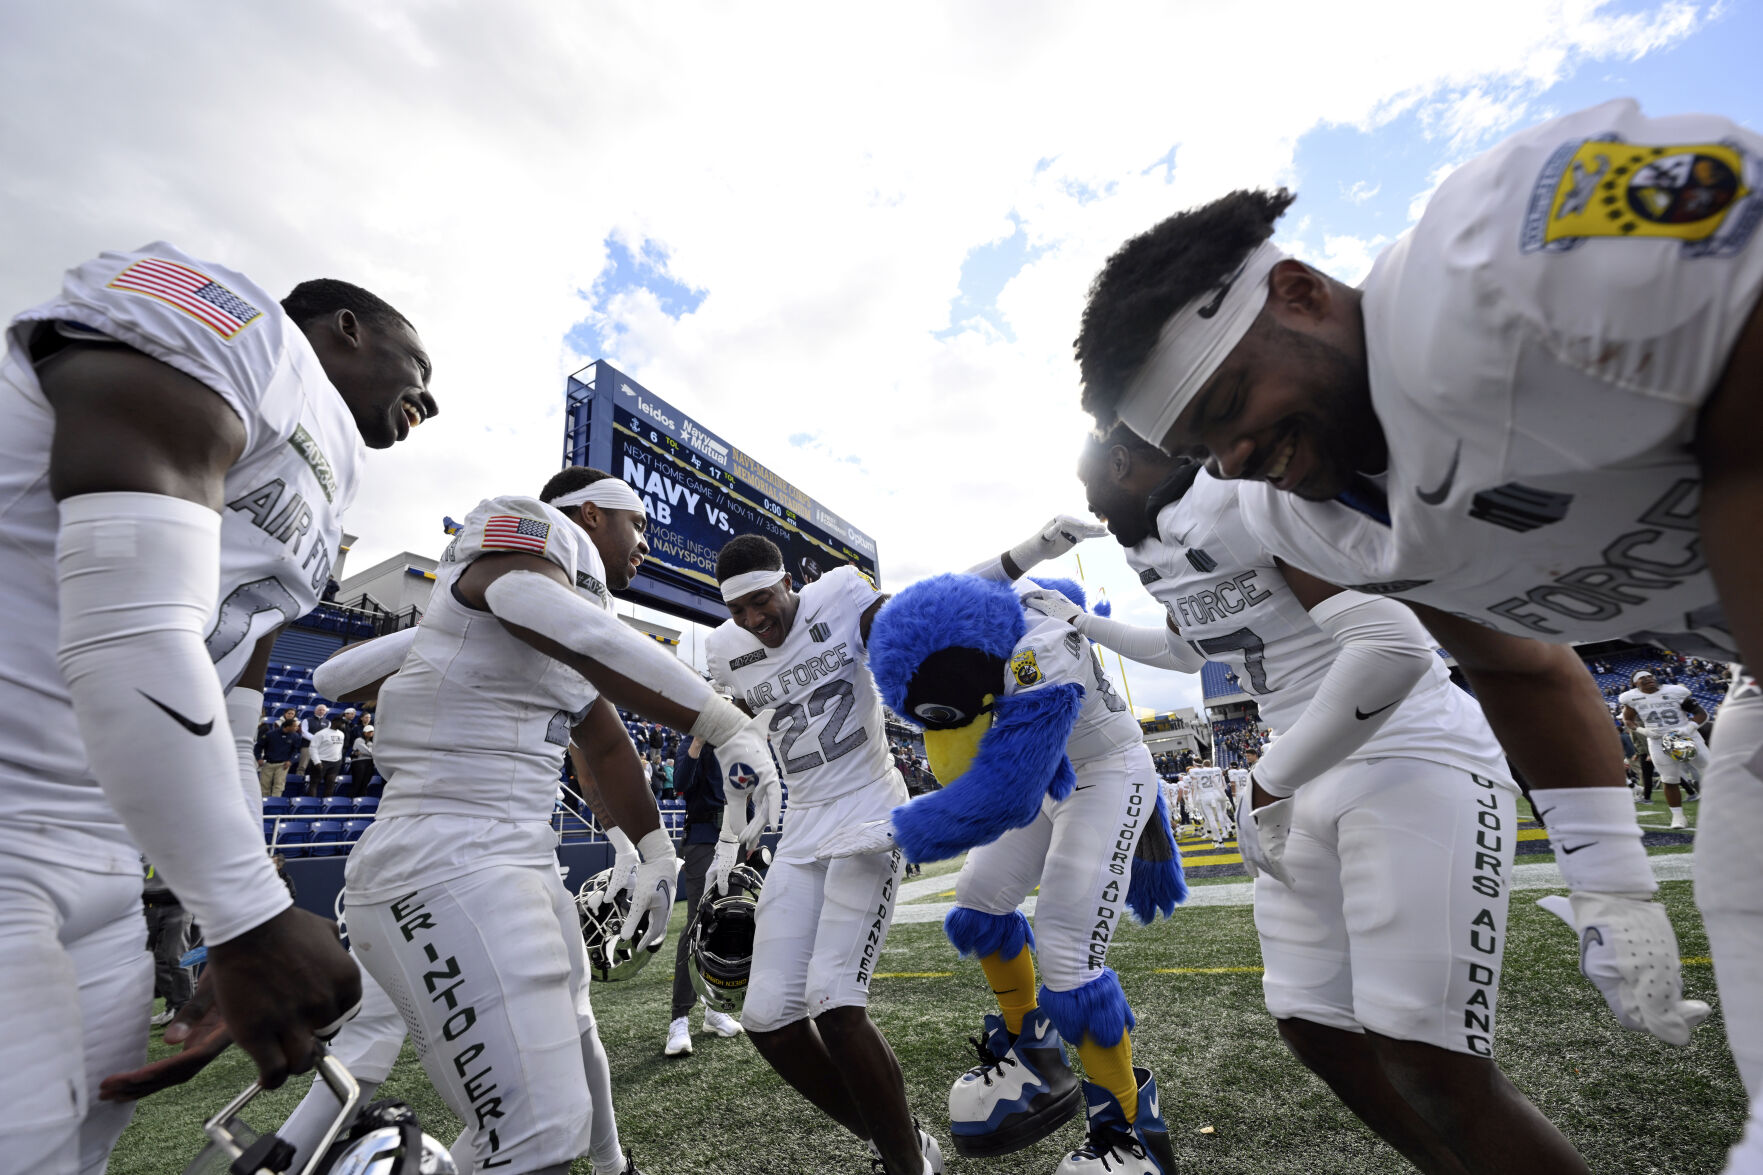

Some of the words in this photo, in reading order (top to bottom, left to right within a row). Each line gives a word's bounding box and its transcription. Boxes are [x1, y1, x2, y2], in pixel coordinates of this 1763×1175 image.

[638, 396, 675, 430] leidos
[683, 420, 711, 446] Navy
[650, 432, 658, 443] 6
[665, 436, 680, 450] TOL
[691, 437, 728, 466] Mutual
[623, 441, 652, 465] NEXT
[654, 459, 686, 484] HOME
[687, 478, 713, 498] GAME
[709, 467, 721, 479] 17
[732, 447, 788, 493] NAVY-MARINE
[733, 463, 779, 501] MEMORIAL
[779, 491, 811, 520] STADIUM
[226, 477, 314, 556] AIR
[623, 455, 700, 515] NAVY
[705, 503, 735, 535] VS.
[633, 489, 672, 525] AB
[764, 498, 781, 516] 0:00
[651, 524, 684, 547] MORE
[848, 528, 875, 554] Optum
[1177, 569, 1273, 627] FORCE
[746, 681, 777, 712] AIR
[777, 642, 855, 696] FORCE
[1187, 627, 1281, 695] 7
[769, 679, 868, 775] 22
[1109, 783, 1144, 876] TOUJOURS
[1101, 880, 1120, 903] AU
[856, 904, 887, 985] DANGER
[1470, 908, 1496, 955] AU
